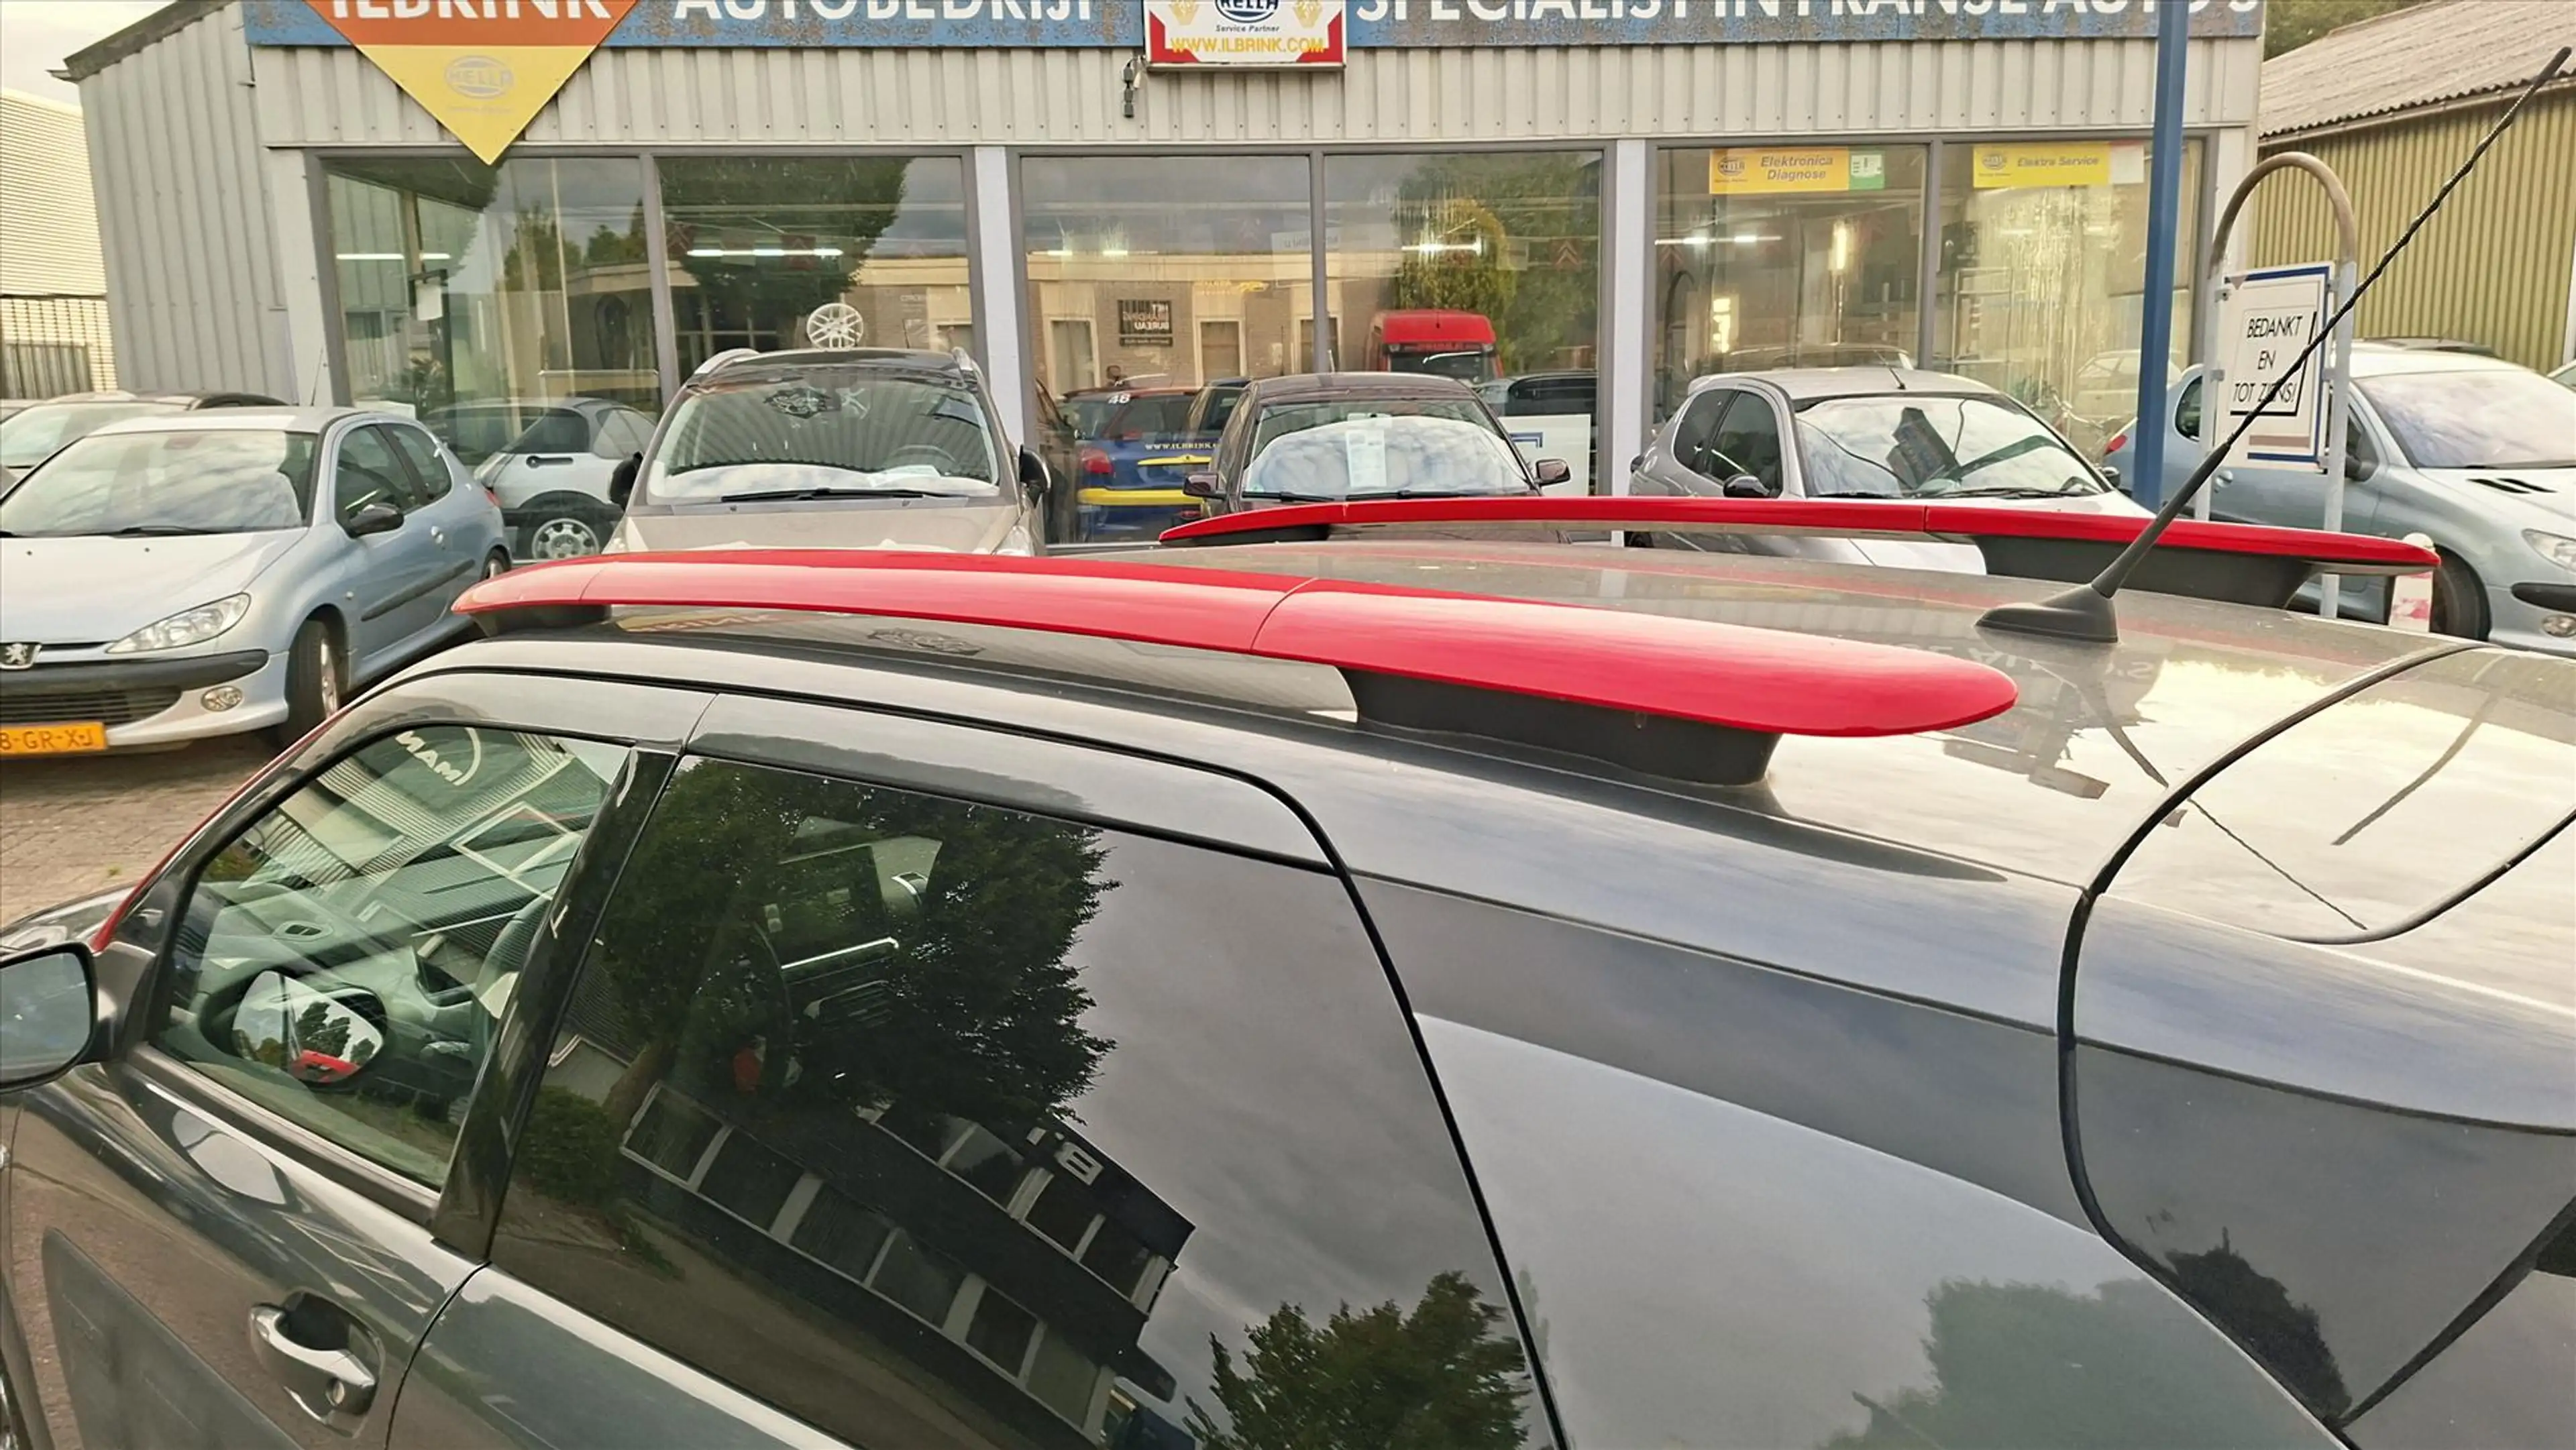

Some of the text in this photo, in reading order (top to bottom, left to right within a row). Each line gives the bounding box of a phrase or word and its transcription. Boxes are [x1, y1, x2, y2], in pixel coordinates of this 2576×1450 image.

[1170, 37, 1324, 53] WWW.ILBRINK.COM
[1760, 154, 1833, 168] Elektronica
[2058, 155, 2099, 166] Service
[1767, 169, 1827, 182] Diagnose
[2247, 315, 2303, 338] BEDANKT
[2258, 350, 2276, 370] EN
[2233, 382, 2256, 402] TOT
